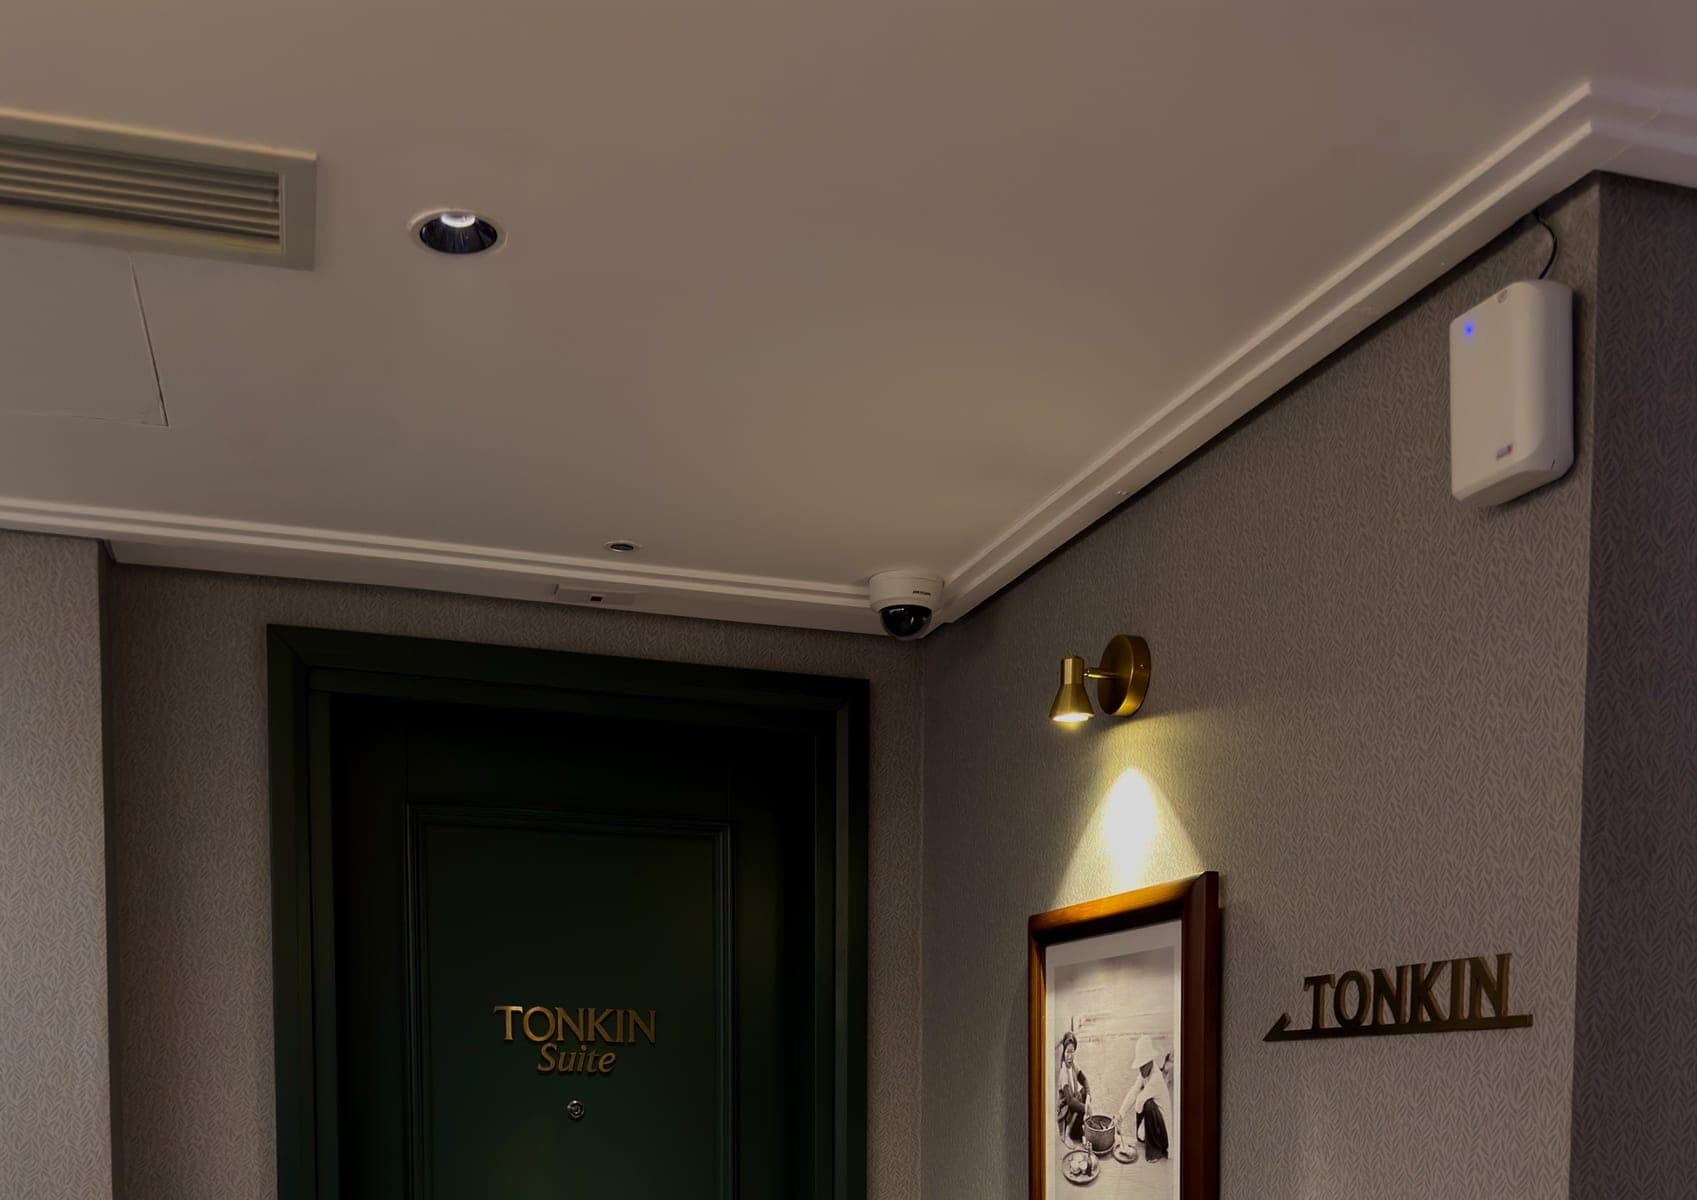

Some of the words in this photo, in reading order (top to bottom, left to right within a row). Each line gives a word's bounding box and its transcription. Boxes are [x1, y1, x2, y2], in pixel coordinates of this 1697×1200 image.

[1303, 953, 1512, 1030] TONKIN
[493, 1005, 657, 1044] TONKIN
[536, 1042, 617, 1074] Suite
